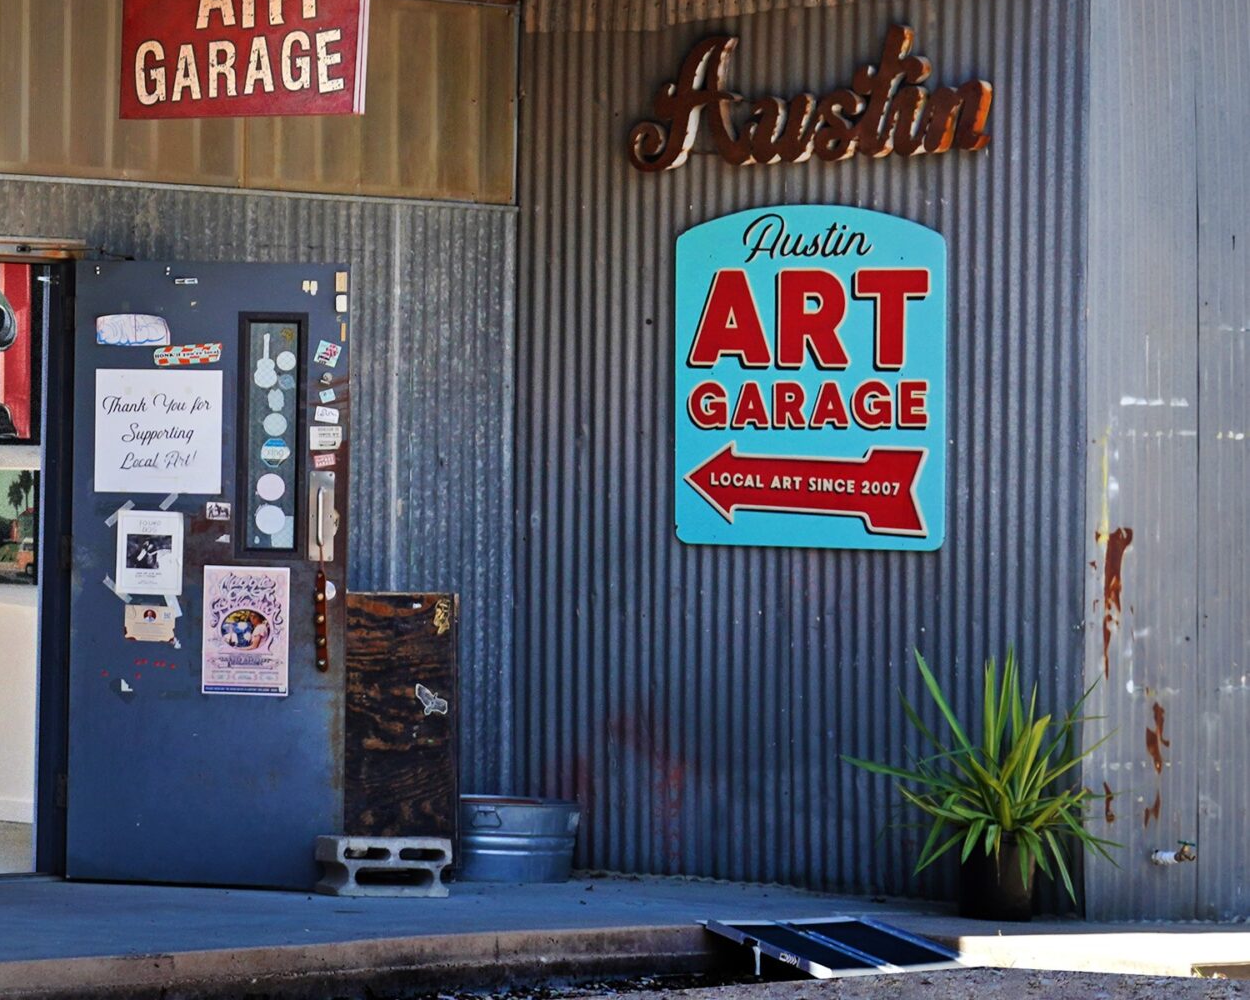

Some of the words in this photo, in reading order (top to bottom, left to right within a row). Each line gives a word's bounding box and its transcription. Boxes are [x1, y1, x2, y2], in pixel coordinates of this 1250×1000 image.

[135, 28, 345, 106] GARAGE
[628, 23, 993, 173] Austin
[742, 213, 874, 264] Austin
[687, 267, 930, 371] ART
[102, 395, 147, 415] Thank
[152, 393, 187, 415] You
[189, 396, 212, 415] for
[687, 379, 929, 431] GARAGE
[121, 422, 194, 446] Supporting
[120, 451, 160, 470] Local
[164, 450, 198, 469] Art!
[710, 472, 765, 489] LOCAL
[770, 475, 803, 491] ART
[808, 477, 856, 494] SINCE
[861, 479, 901, 496] 2007
